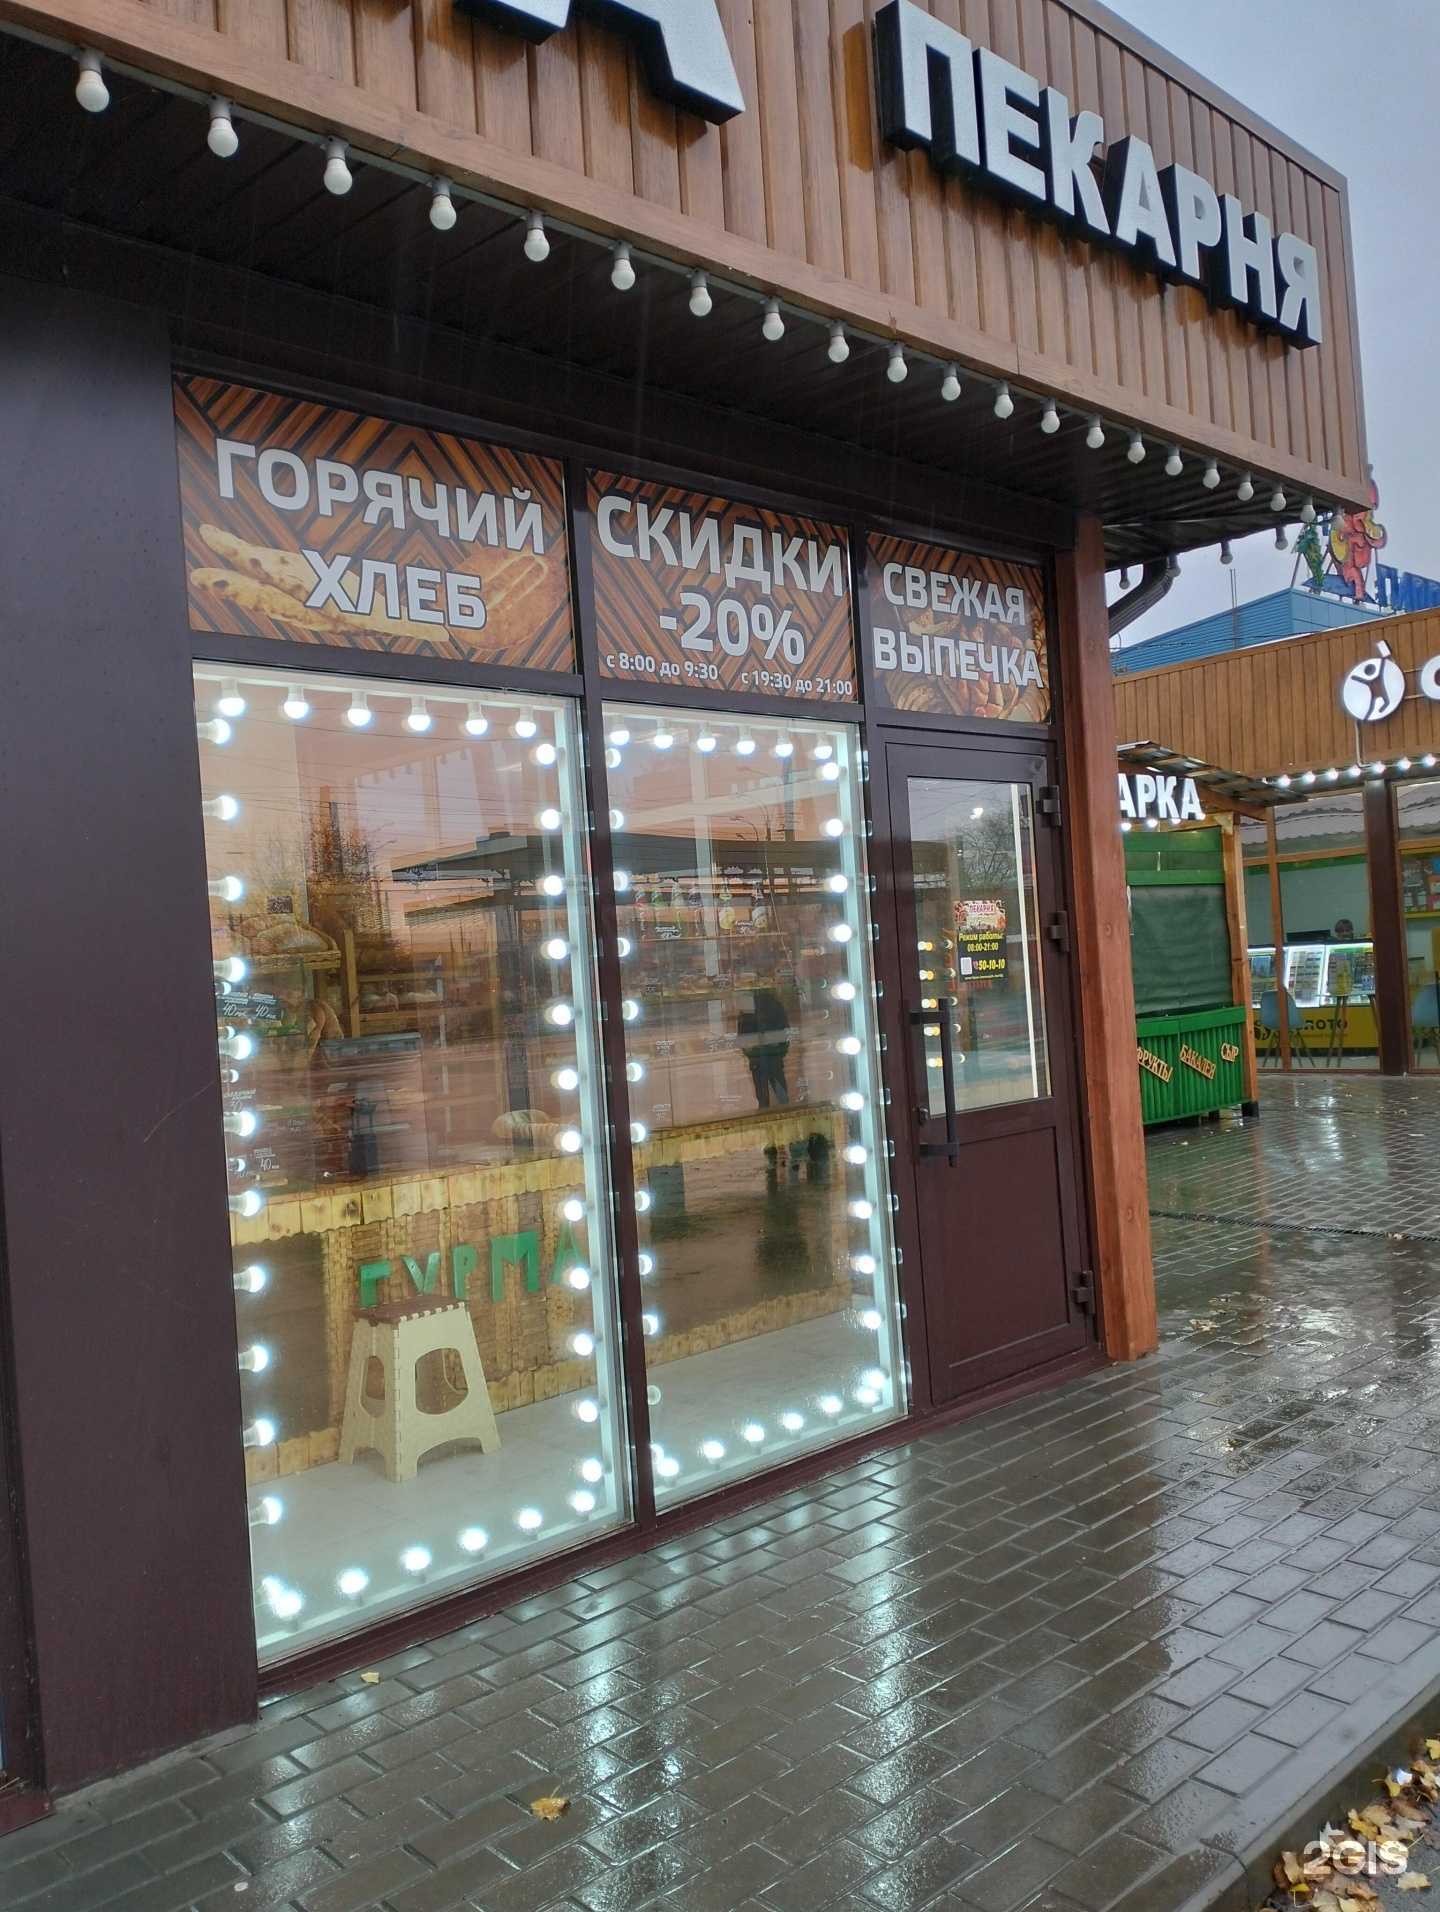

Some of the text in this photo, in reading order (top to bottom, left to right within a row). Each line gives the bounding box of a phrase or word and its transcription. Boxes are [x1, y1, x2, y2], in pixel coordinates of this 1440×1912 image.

[893, 0, 1322, 347] ПЕКАРНЯ
[215, 437, 545, 554] ГОРЯЧИЙ
[597, 495, 843, 597] СКИДКИ
[301, 547, 487, 630] ХЛЕБ
[882, 562, 1025, 626] СВЕЖАЯ
[659, 591, 805, 664] -20%
[872, 627, 1044, 688] ВЫПЕЧКА
[606, 652, 718, 681] с 8:00 до 9:30
[741, 670, 853, 696] с 19:30 до 21:00
[1180, 1044, 1216, 1080] БАКАЛЕЯ
[1221, 1042, 1239, 1062] СЫР
